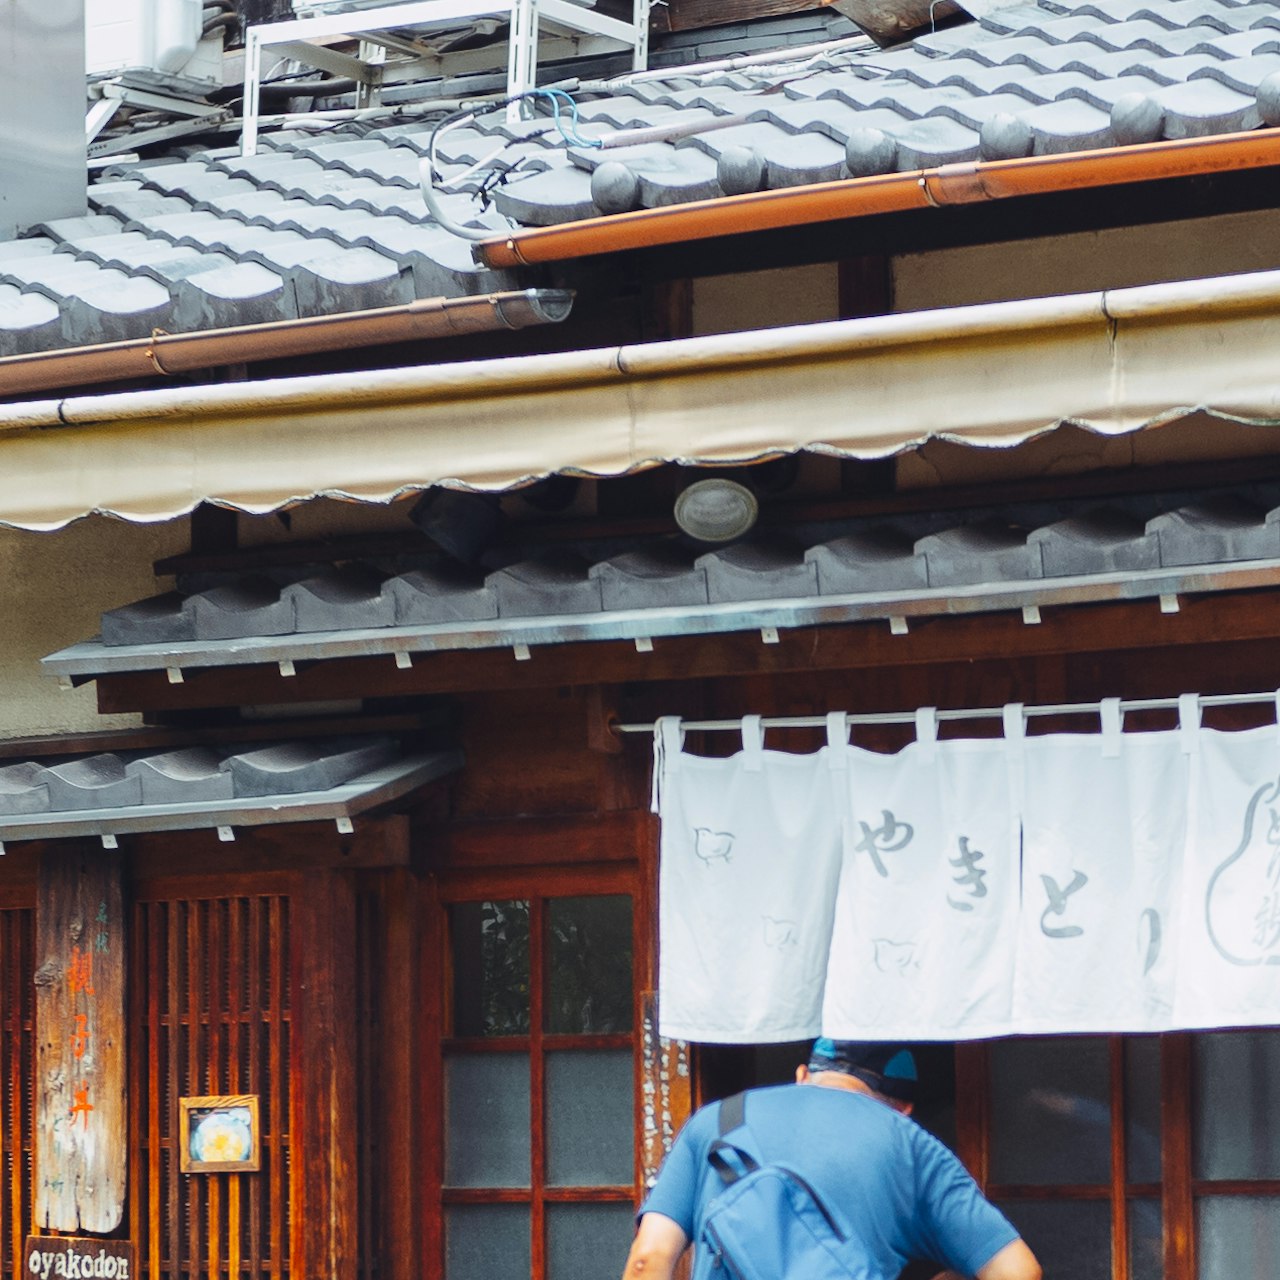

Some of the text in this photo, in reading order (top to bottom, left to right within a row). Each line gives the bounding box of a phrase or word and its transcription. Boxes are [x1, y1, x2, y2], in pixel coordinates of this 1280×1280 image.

[66, 945, 96, 1132] 親子丼
[28, 1248, 129, 1280] oyakodon
